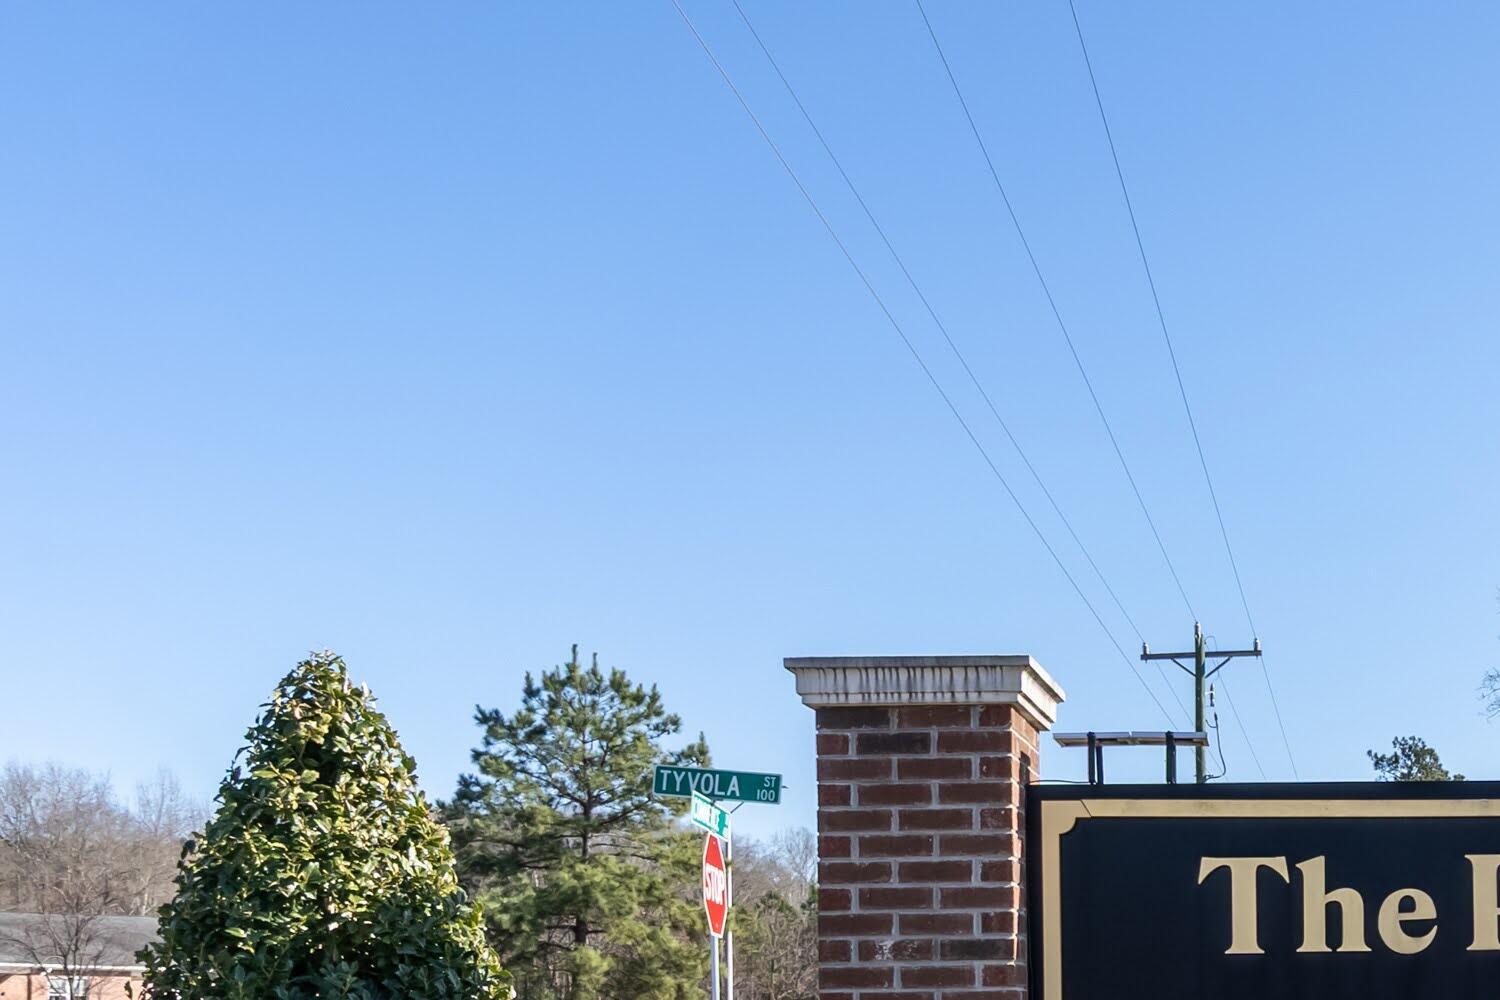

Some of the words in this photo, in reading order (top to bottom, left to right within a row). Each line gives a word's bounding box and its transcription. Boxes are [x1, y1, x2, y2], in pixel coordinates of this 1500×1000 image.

[660, 769, 740, 797] TYVOLA
[764, 776, 776, 788] ST
[756, 789, 776, 801] 100
[704, 862, 725, 906] STOP
[1198, 855, 1438, 955] The
